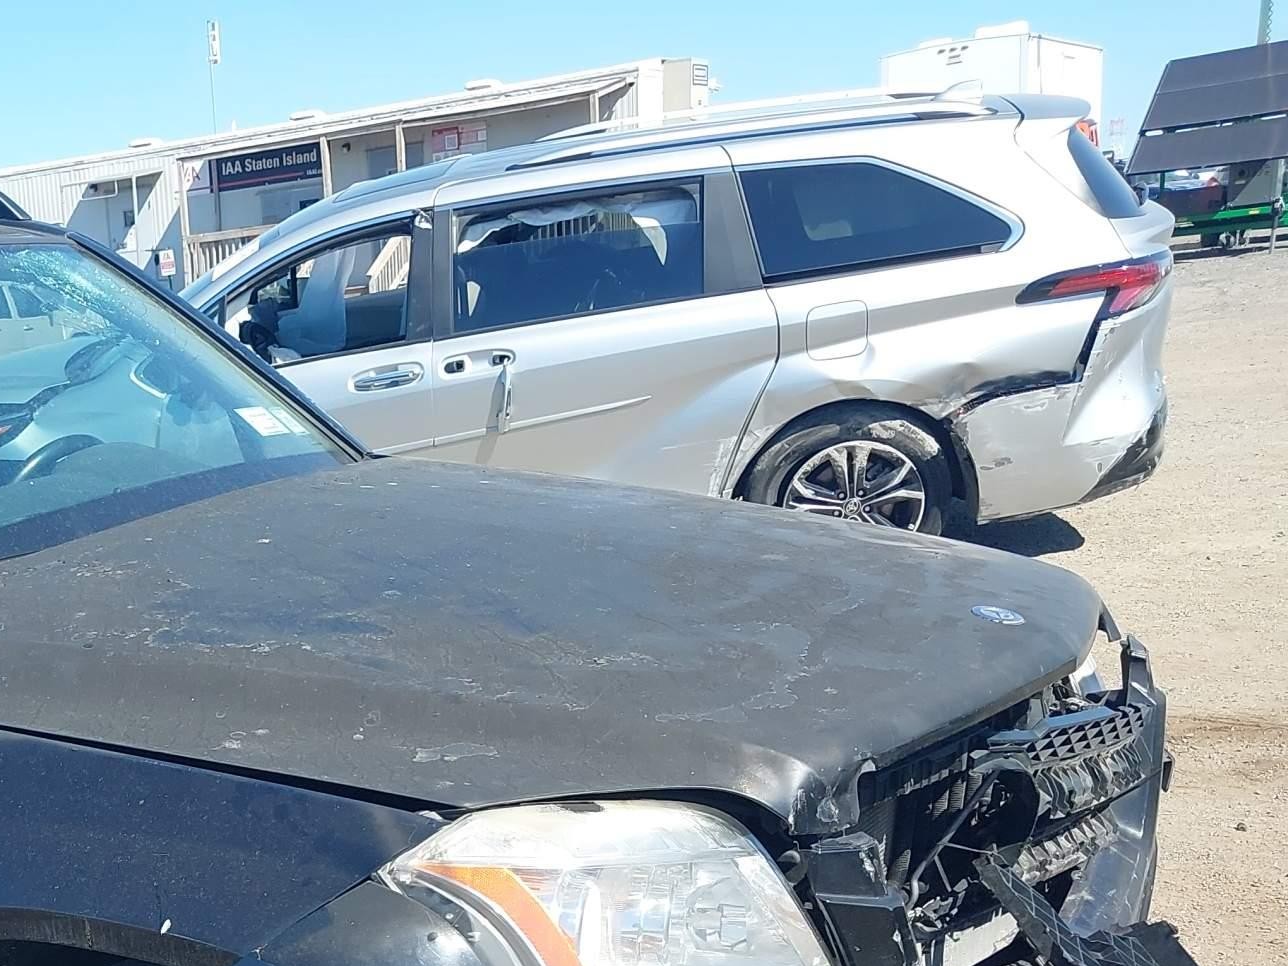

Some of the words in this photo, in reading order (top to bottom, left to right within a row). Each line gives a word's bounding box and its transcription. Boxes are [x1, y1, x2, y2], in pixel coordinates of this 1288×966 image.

[222, 160, 243, 176] IAA
[244, 156, 280, 173] Staten
[283, 148, 317, 166] Island
